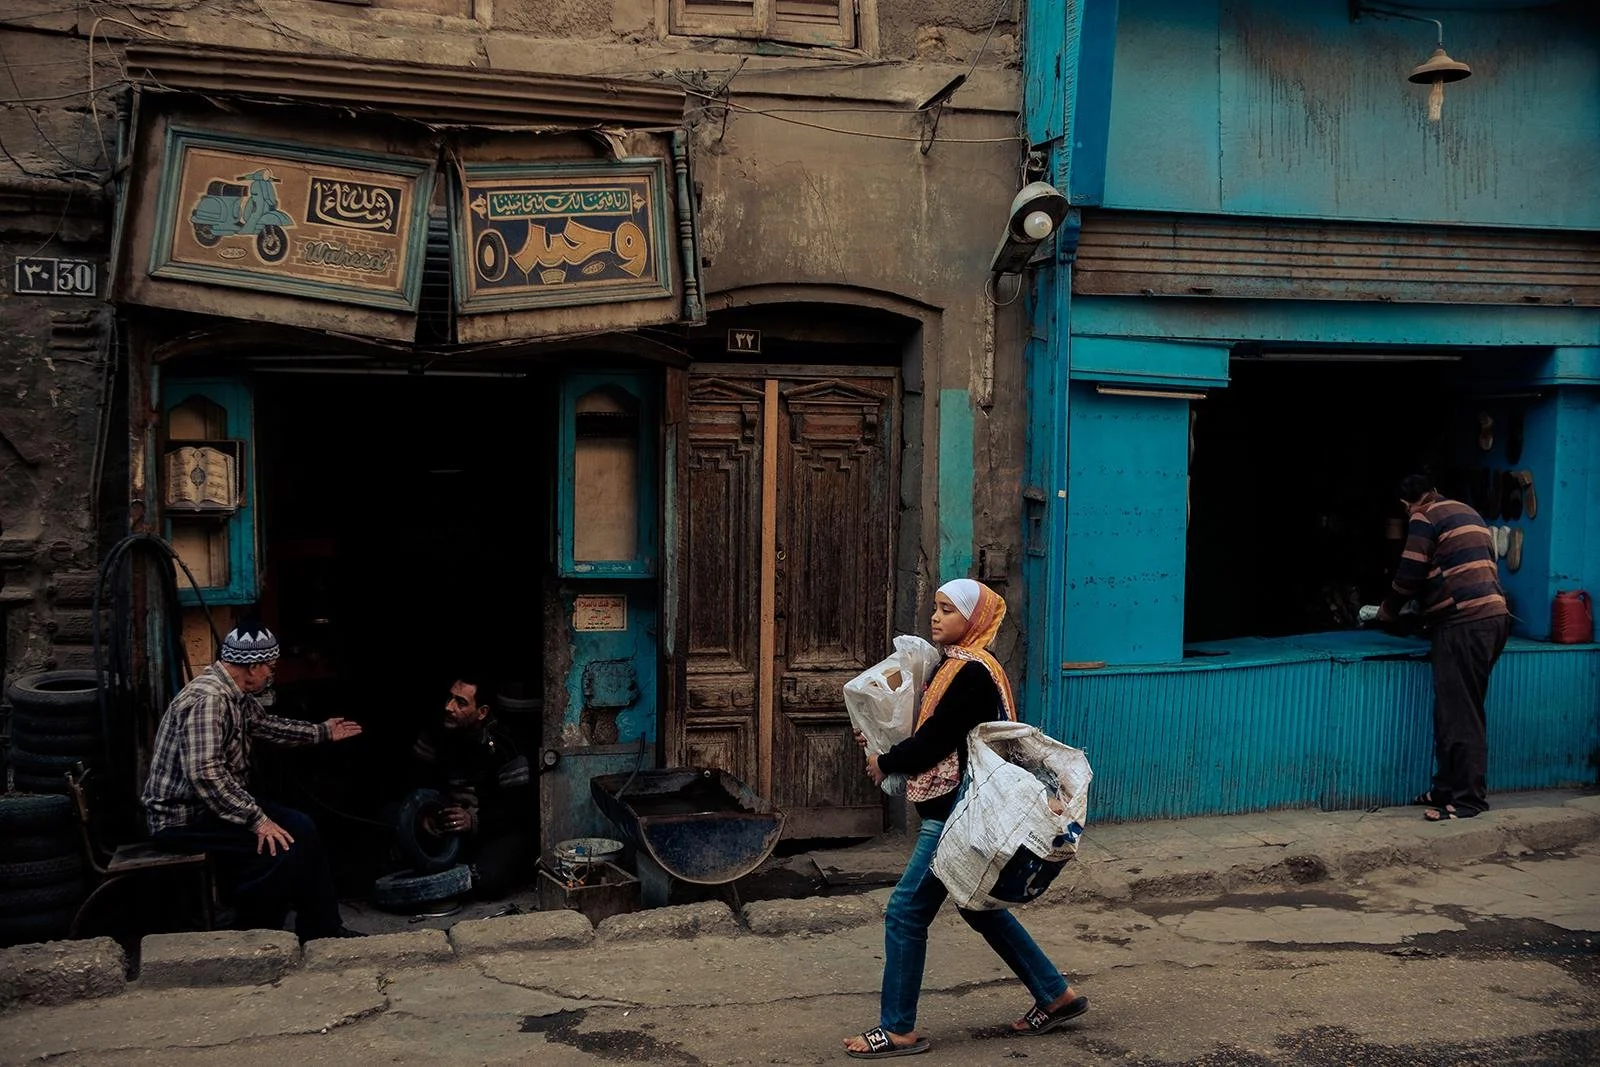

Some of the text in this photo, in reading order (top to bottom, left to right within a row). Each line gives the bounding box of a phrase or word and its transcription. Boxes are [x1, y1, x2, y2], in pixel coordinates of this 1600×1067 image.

[304, 240, 391, 272] Waheed
[24, 264, 50, 288] ٣٠
[58, 263, 92, 291] 30
[735, 332, 755, 349] ٣٢
